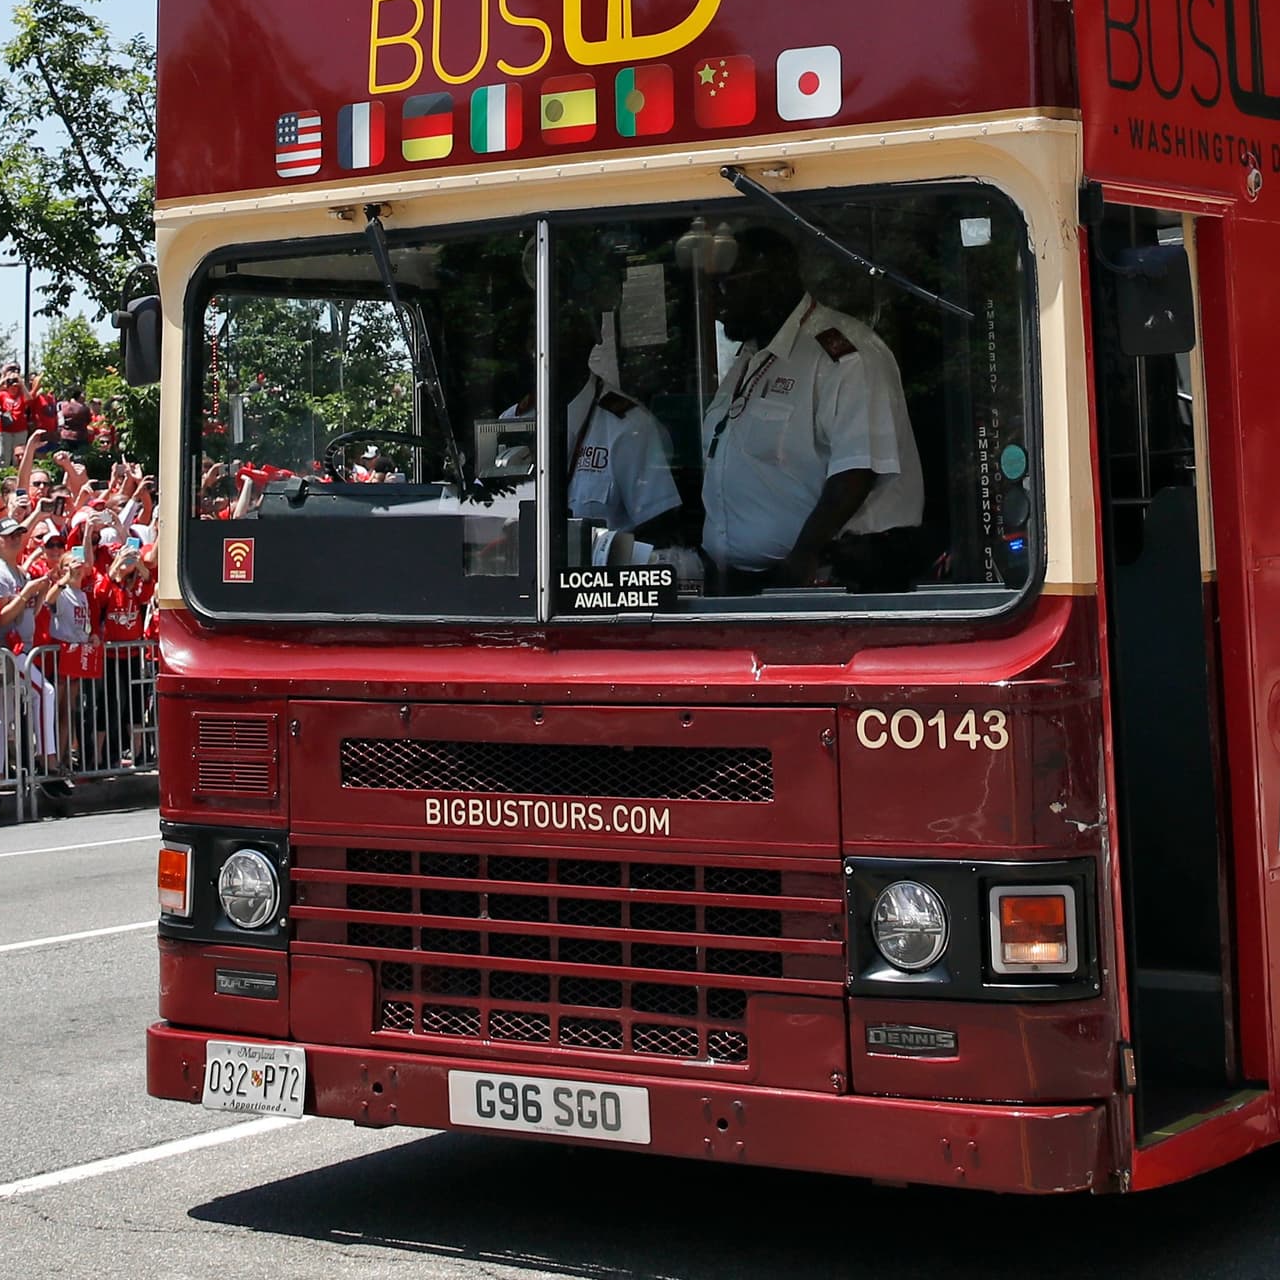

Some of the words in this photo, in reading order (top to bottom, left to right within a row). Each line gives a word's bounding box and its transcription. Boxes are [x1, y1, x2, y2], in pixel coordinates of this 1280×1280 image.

[1128, 120, 1262, 168] WASHINGTON
[560, 572, 614, 588] LOCAL
[620, 570, 672, 587] FARES
[574, 591, 659, 608] AVAILABLE
[856, 708, 1009, 751] CO143
[425, 798, 670, 836] BIGBUSTOURS.COM
[868, 1029, 955, 1049] DENNIS
[237, 1047, 276, 1062] Maryland
[263, 1064, 300, 1102] P72
[229, 1099, 282, 1112] Apportioned
[475, 1079, 543, 1124] G96
[552, 1086, 622, 1132] SGO
